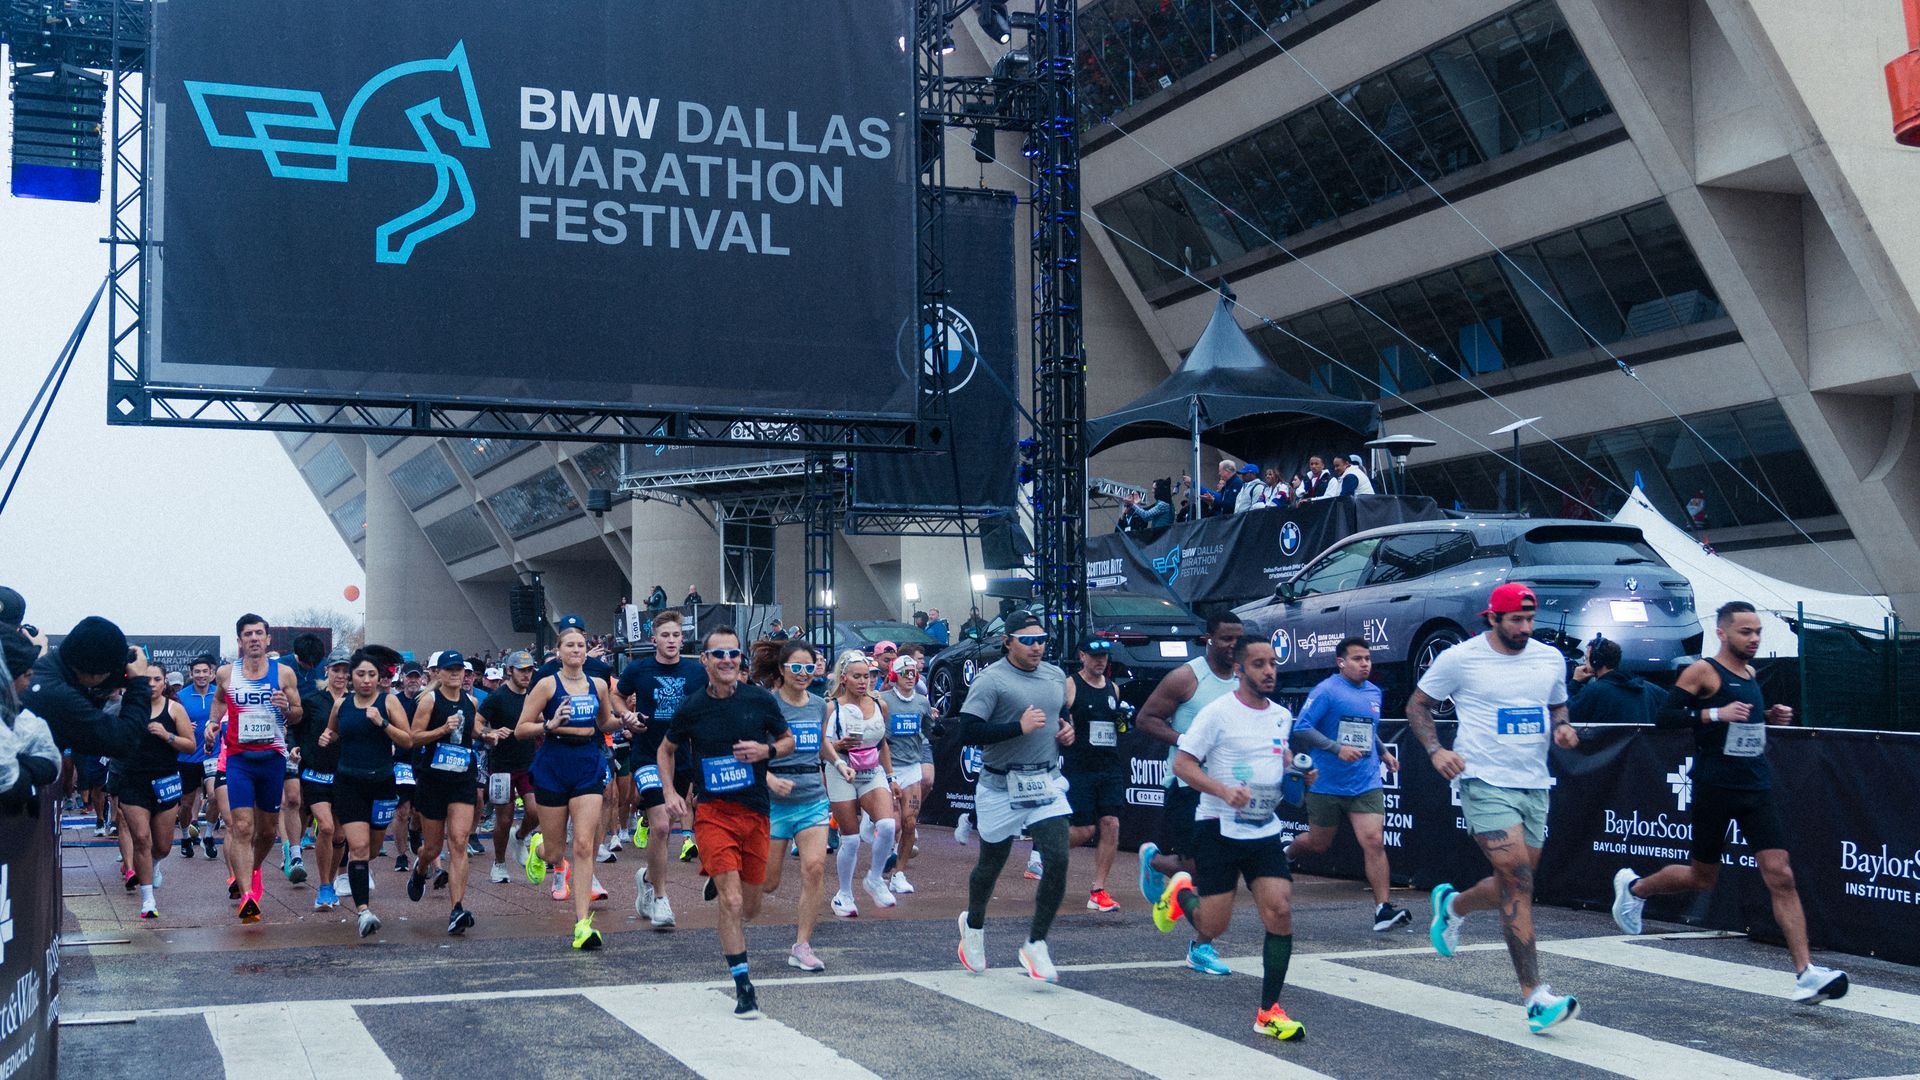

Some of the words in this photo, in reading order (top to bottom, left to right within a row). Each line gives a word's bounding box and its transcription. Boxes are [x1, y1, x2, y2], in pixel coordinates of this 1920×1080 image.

[520, 86, 660, 140] BMW
[677, 100, 892, 160] DALLAS
[520, 141, 843, 208] MARATHON
[520, 195, 791, 256] FESTIVAL
[1182, 548, 1197, 558] BMW
[1196, 544, 1224, 556] DALLAS
[1087, 560, 1110, 577] SCOTTISH
[1111, 558, 1123, 574] RITE
[1181, 555, 1217, 568] MARATHON
[1181, 566, 1209, 577] FESTIVAL
[1371, 617, 1389, 642] iX
[153, 649, 175, 657] BMW
[712, 772, 718, 784] A
[1130, 757, 1169, 786] SCOTTIS
[1018, 782, 1024, 792] B
[1604, 809, 1693, 842] BaylorScot
[1383, 830, 1402, 848] NK
[1593, 841, 1627, 854] BAYLOR
[1630, 844, 1690, 860] UNIVERSITY
[1840, 840, 1920, 883] Baylor
[1845, 881, 1911, 904] INSTITUTE
